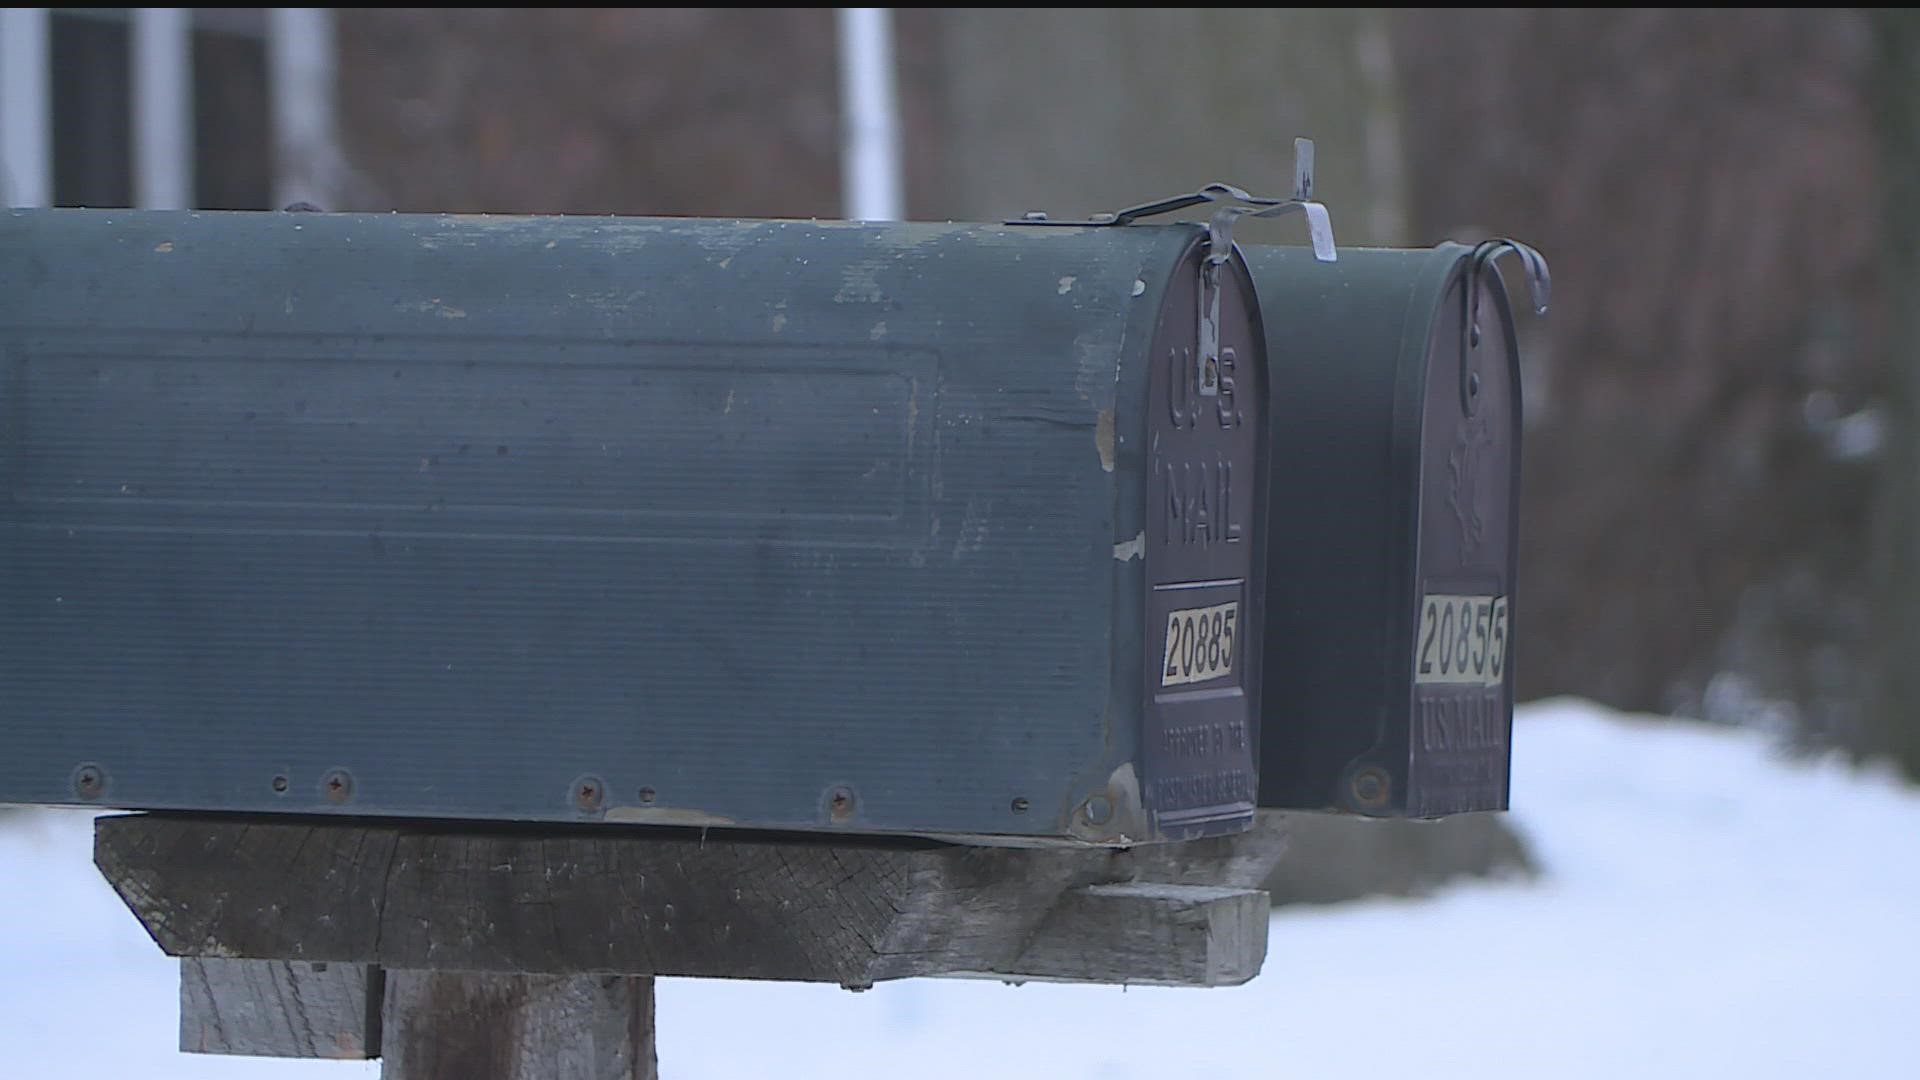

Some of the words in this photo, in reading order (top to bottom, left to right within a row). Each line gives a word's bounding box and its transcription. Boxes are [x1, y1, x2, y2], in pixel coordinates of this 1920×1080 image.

[1165, 460, 1241, 545] MAIL
[1165, 609, 1236, 677] 20885
[1418, 600, 1506, 678] 20855
